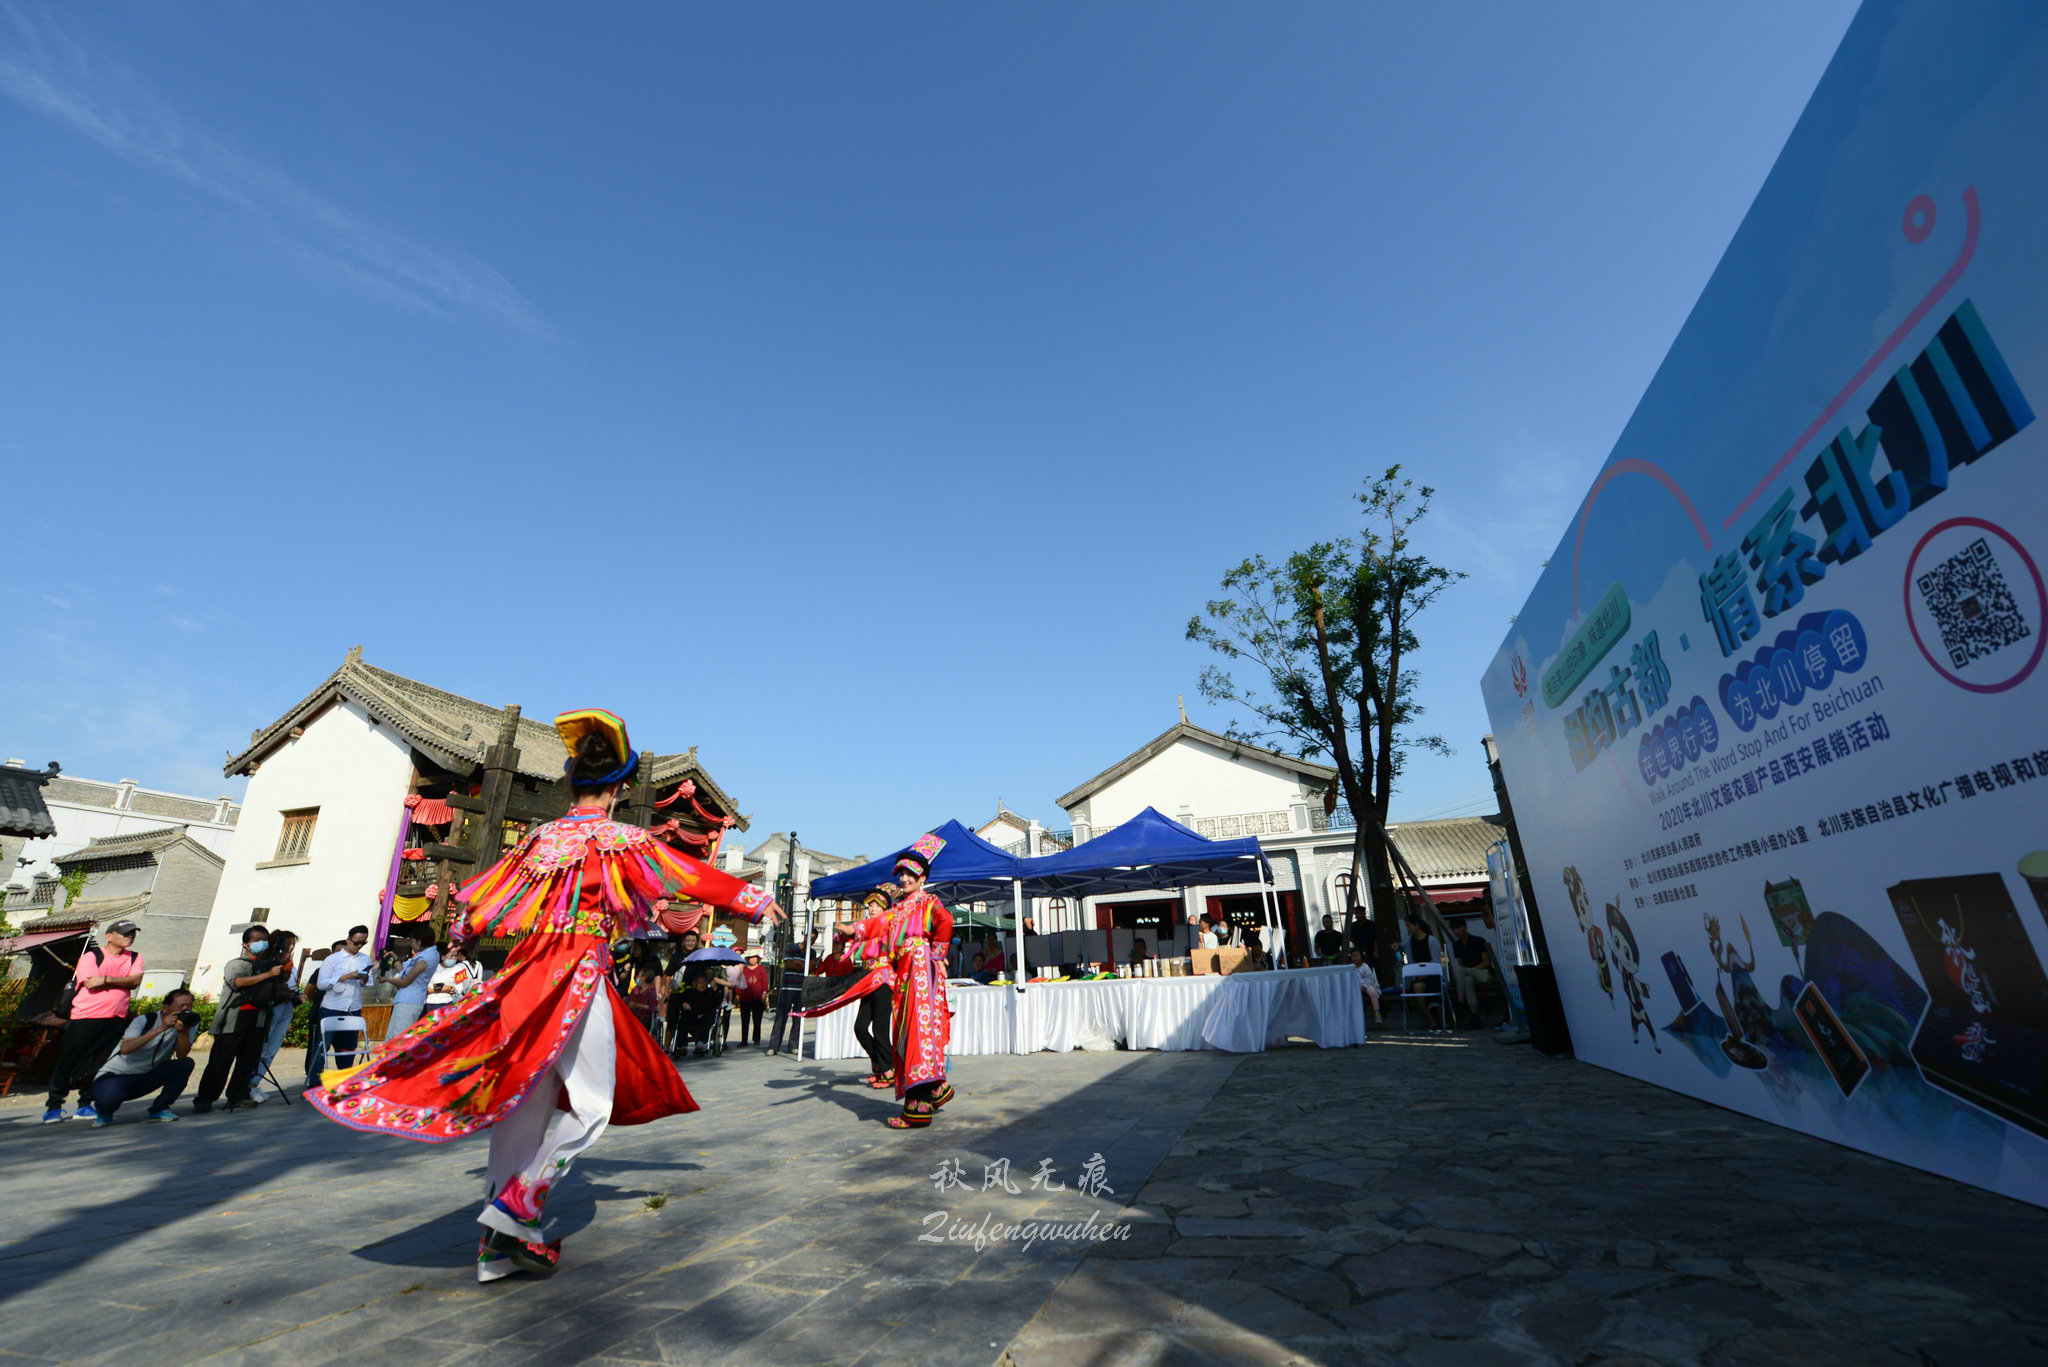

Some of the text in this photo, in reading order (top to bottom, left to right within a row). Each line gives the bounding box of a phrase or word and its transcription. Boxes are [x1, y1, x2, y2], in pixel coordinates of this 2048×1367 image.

[1641, 622, 1861, 781] 在世界行走 为北川停留
[1648, 675, 1884, 805] Walk Around The Word Stop And For Beichuan
[1659, 711, 1890, 831] 2020年北川文旅农副产品西安展销活动
